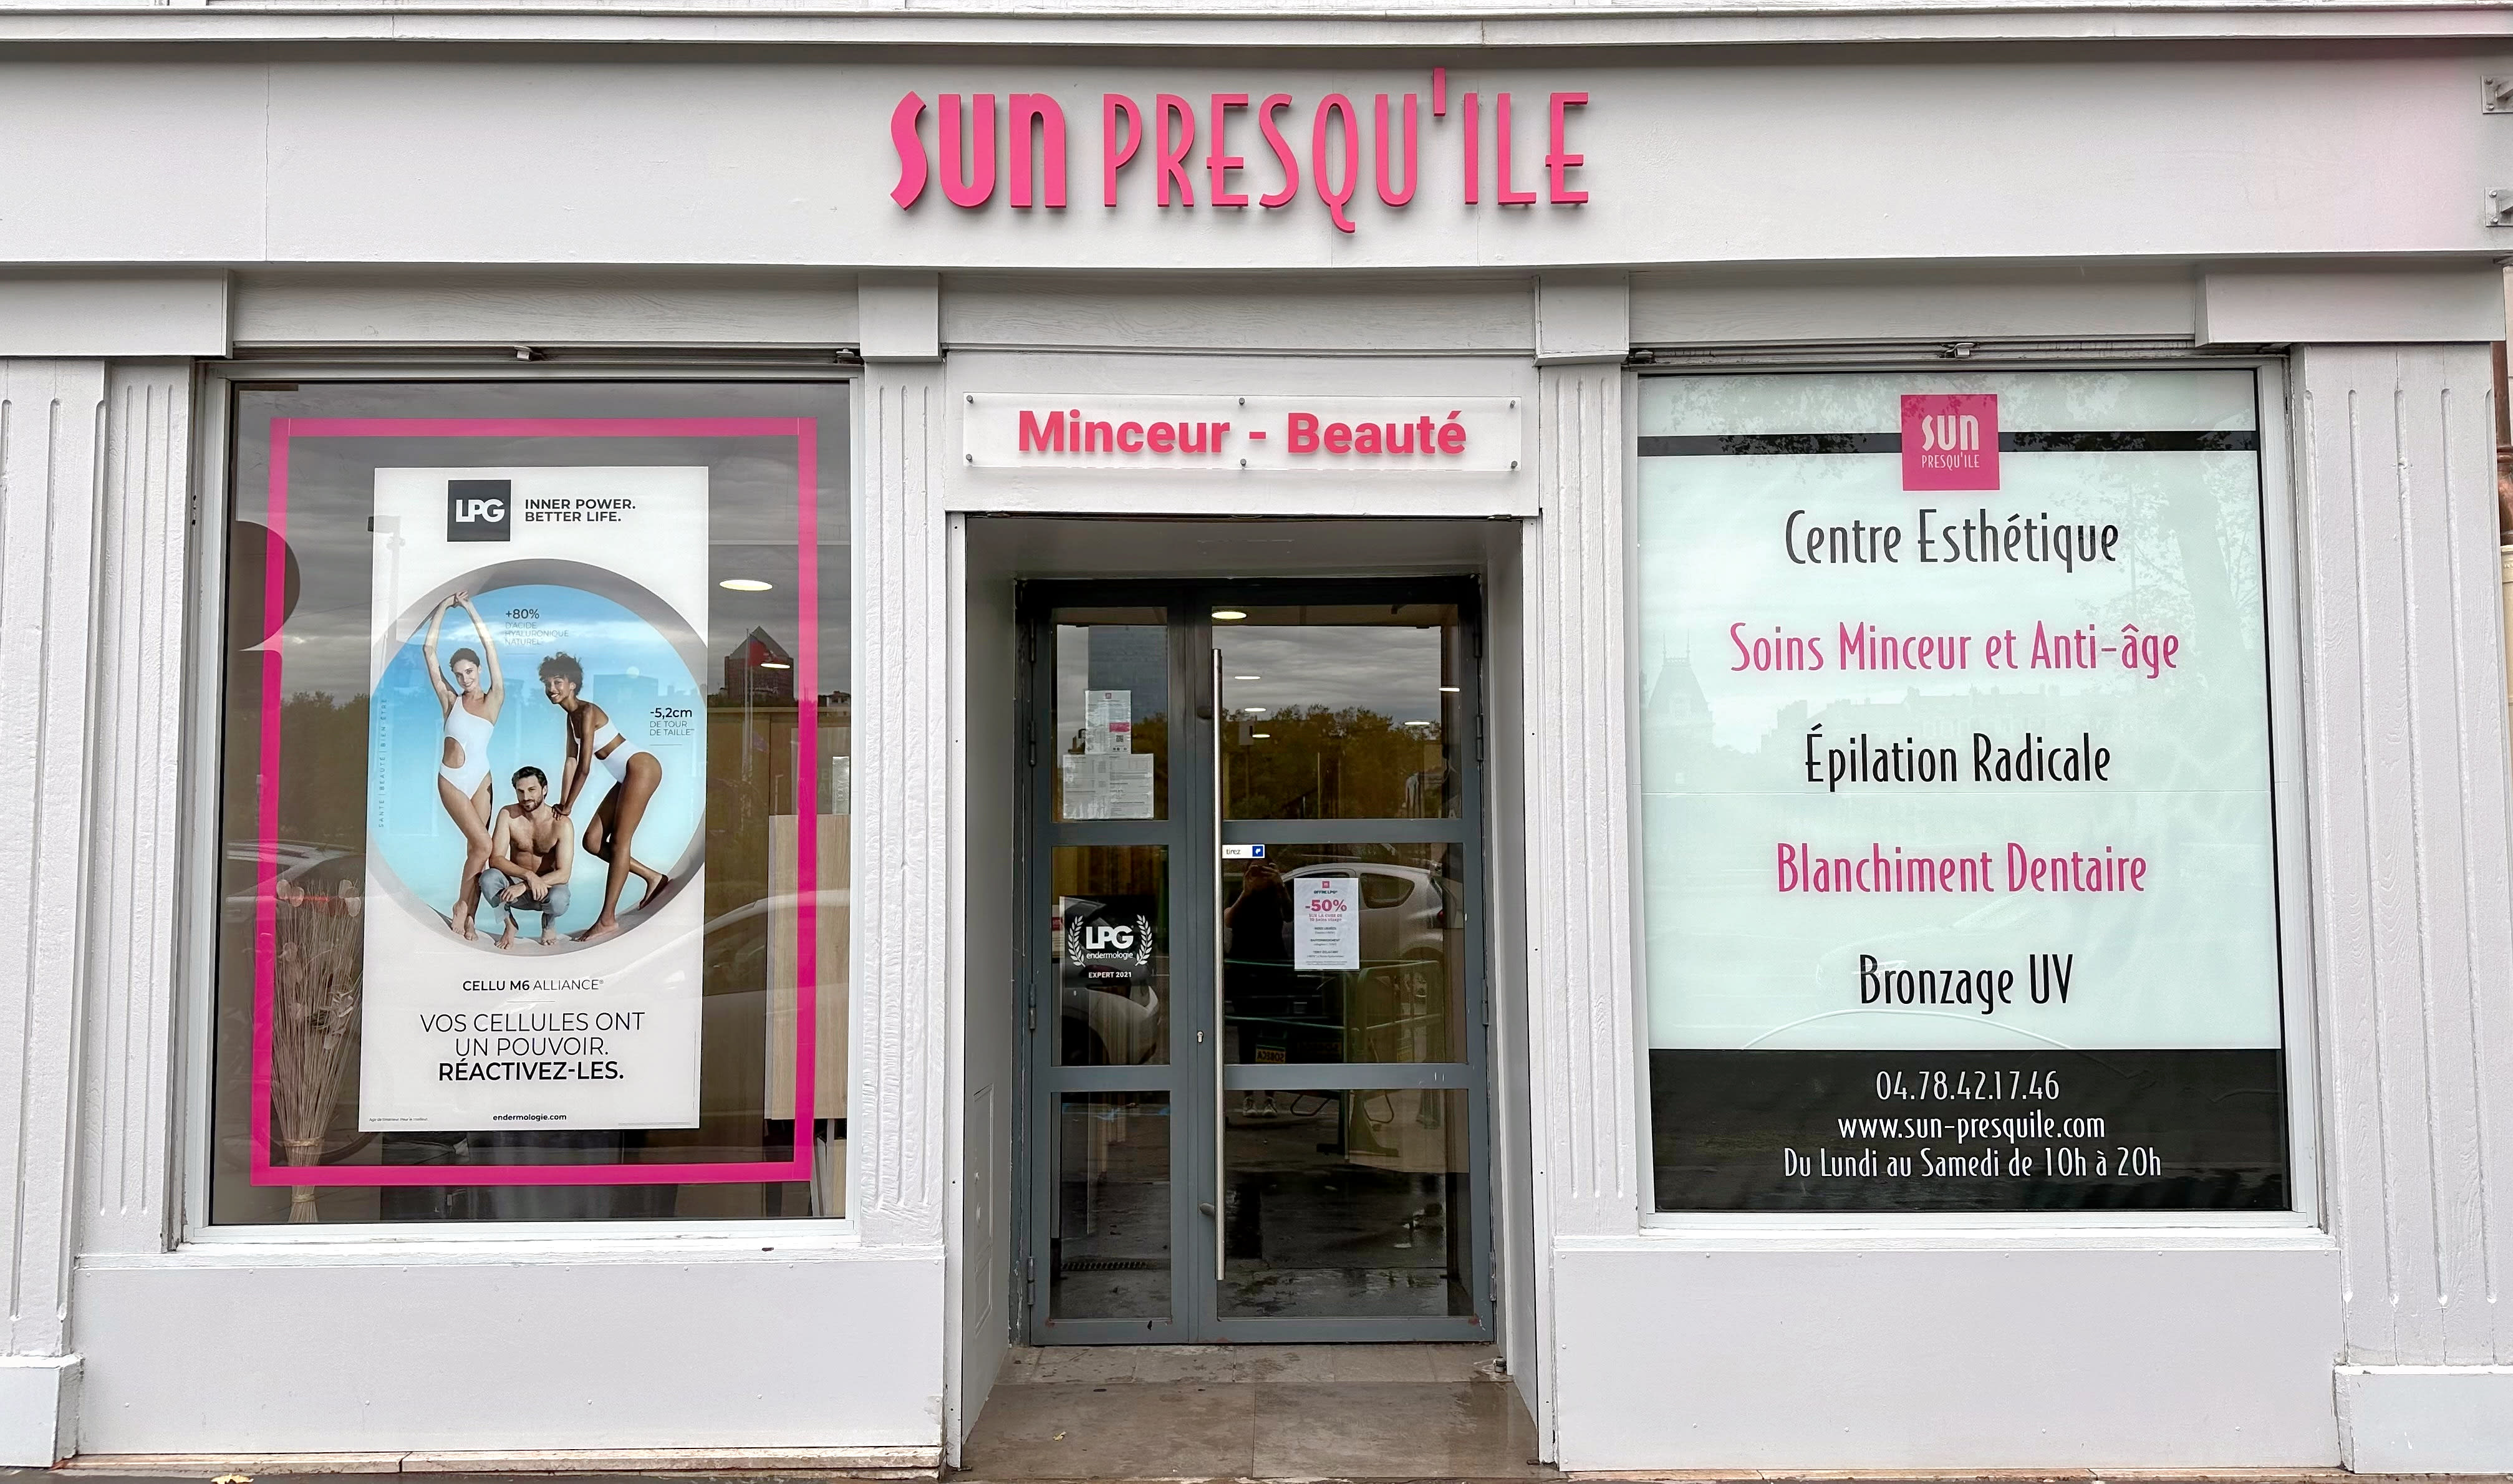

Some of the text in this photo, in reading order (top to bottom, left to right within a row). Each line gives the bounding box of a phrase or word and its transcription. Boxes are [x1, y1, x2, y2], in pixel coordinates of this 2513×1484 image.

[890, 67, 1589, 233] SUN PRESQU'ILE
[1019, 410, 1230, 454] Minceur
[1288, 410, 1467, 457] Beauté
[1921, 415, 1979, 451] SUN
[1921, 451, 1980, 471] PRESQU'ILE
[455, 498, 505, 523] LPG
[525, 499, 636, 509] INNER POWER.
[525, 511, 622, 522] BETTER LIFE.
[1785, 508, 2118, 574] Centre Esthétique
[505, 609, 539, 619] +80%
[1730, 620, 2179, 679] Soins Minceur et Anti-âge
[650, 707, 692, 720] -5,2cm
[1805, 723, 2110, 793] Épilation Radicale
[1777, 842, 2146, 893] Blanchiment Dentaire
[1305, 899, 1347, 912] -50%
[1086, 925, 1134, 949] LPG
[1086, 951, 1134, 960] endermologie
[463, 980, 506, 991] CELLU
[510, 980, 530, 991] M6
[1859, 953, 2073, 1015] Bronzage UV
[420, 1012, 645, 1033] VOS CELLULES ONT
[456, 1037, 609, 1057] UN POUVOIR.
[439, 1058, 624, 1081] RÉACTIVEZ-LES.
[1876, 1071, 2059, 1100] 04.78.42.17.46
[493, 1114, 567, 1122] endermologie.com
[1838, 1109, 2105, 1144] www.sun-presquile.com
[1784, 1147, 2161, 1177] Du Lundi au Samedi de 10h à 20h
